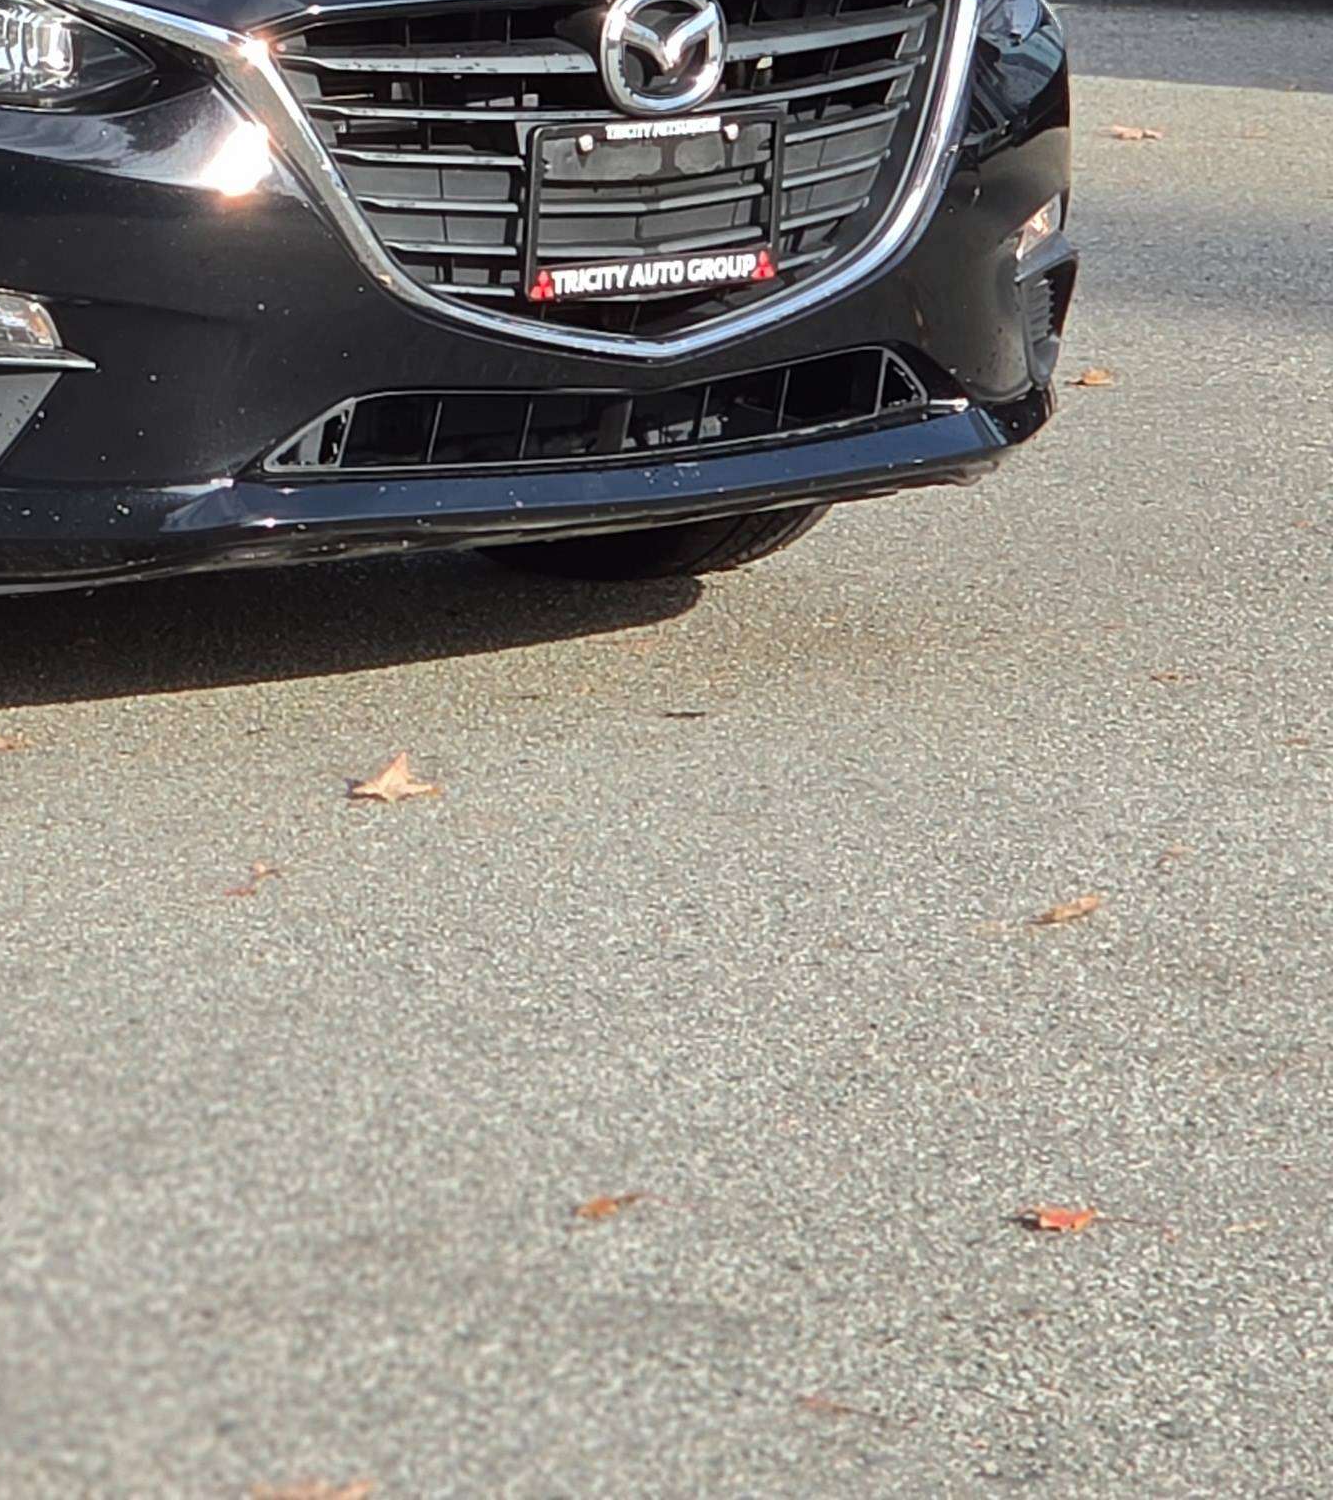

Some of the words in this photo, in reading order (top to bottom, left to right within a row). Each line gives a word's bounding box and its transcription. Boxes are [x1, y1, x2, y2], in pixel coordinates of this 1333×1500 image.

[551, 264, 629, 295] TRICITY
[630, 258, 684, 288] AUTO
[687, 253, 757, 282] GROUP
